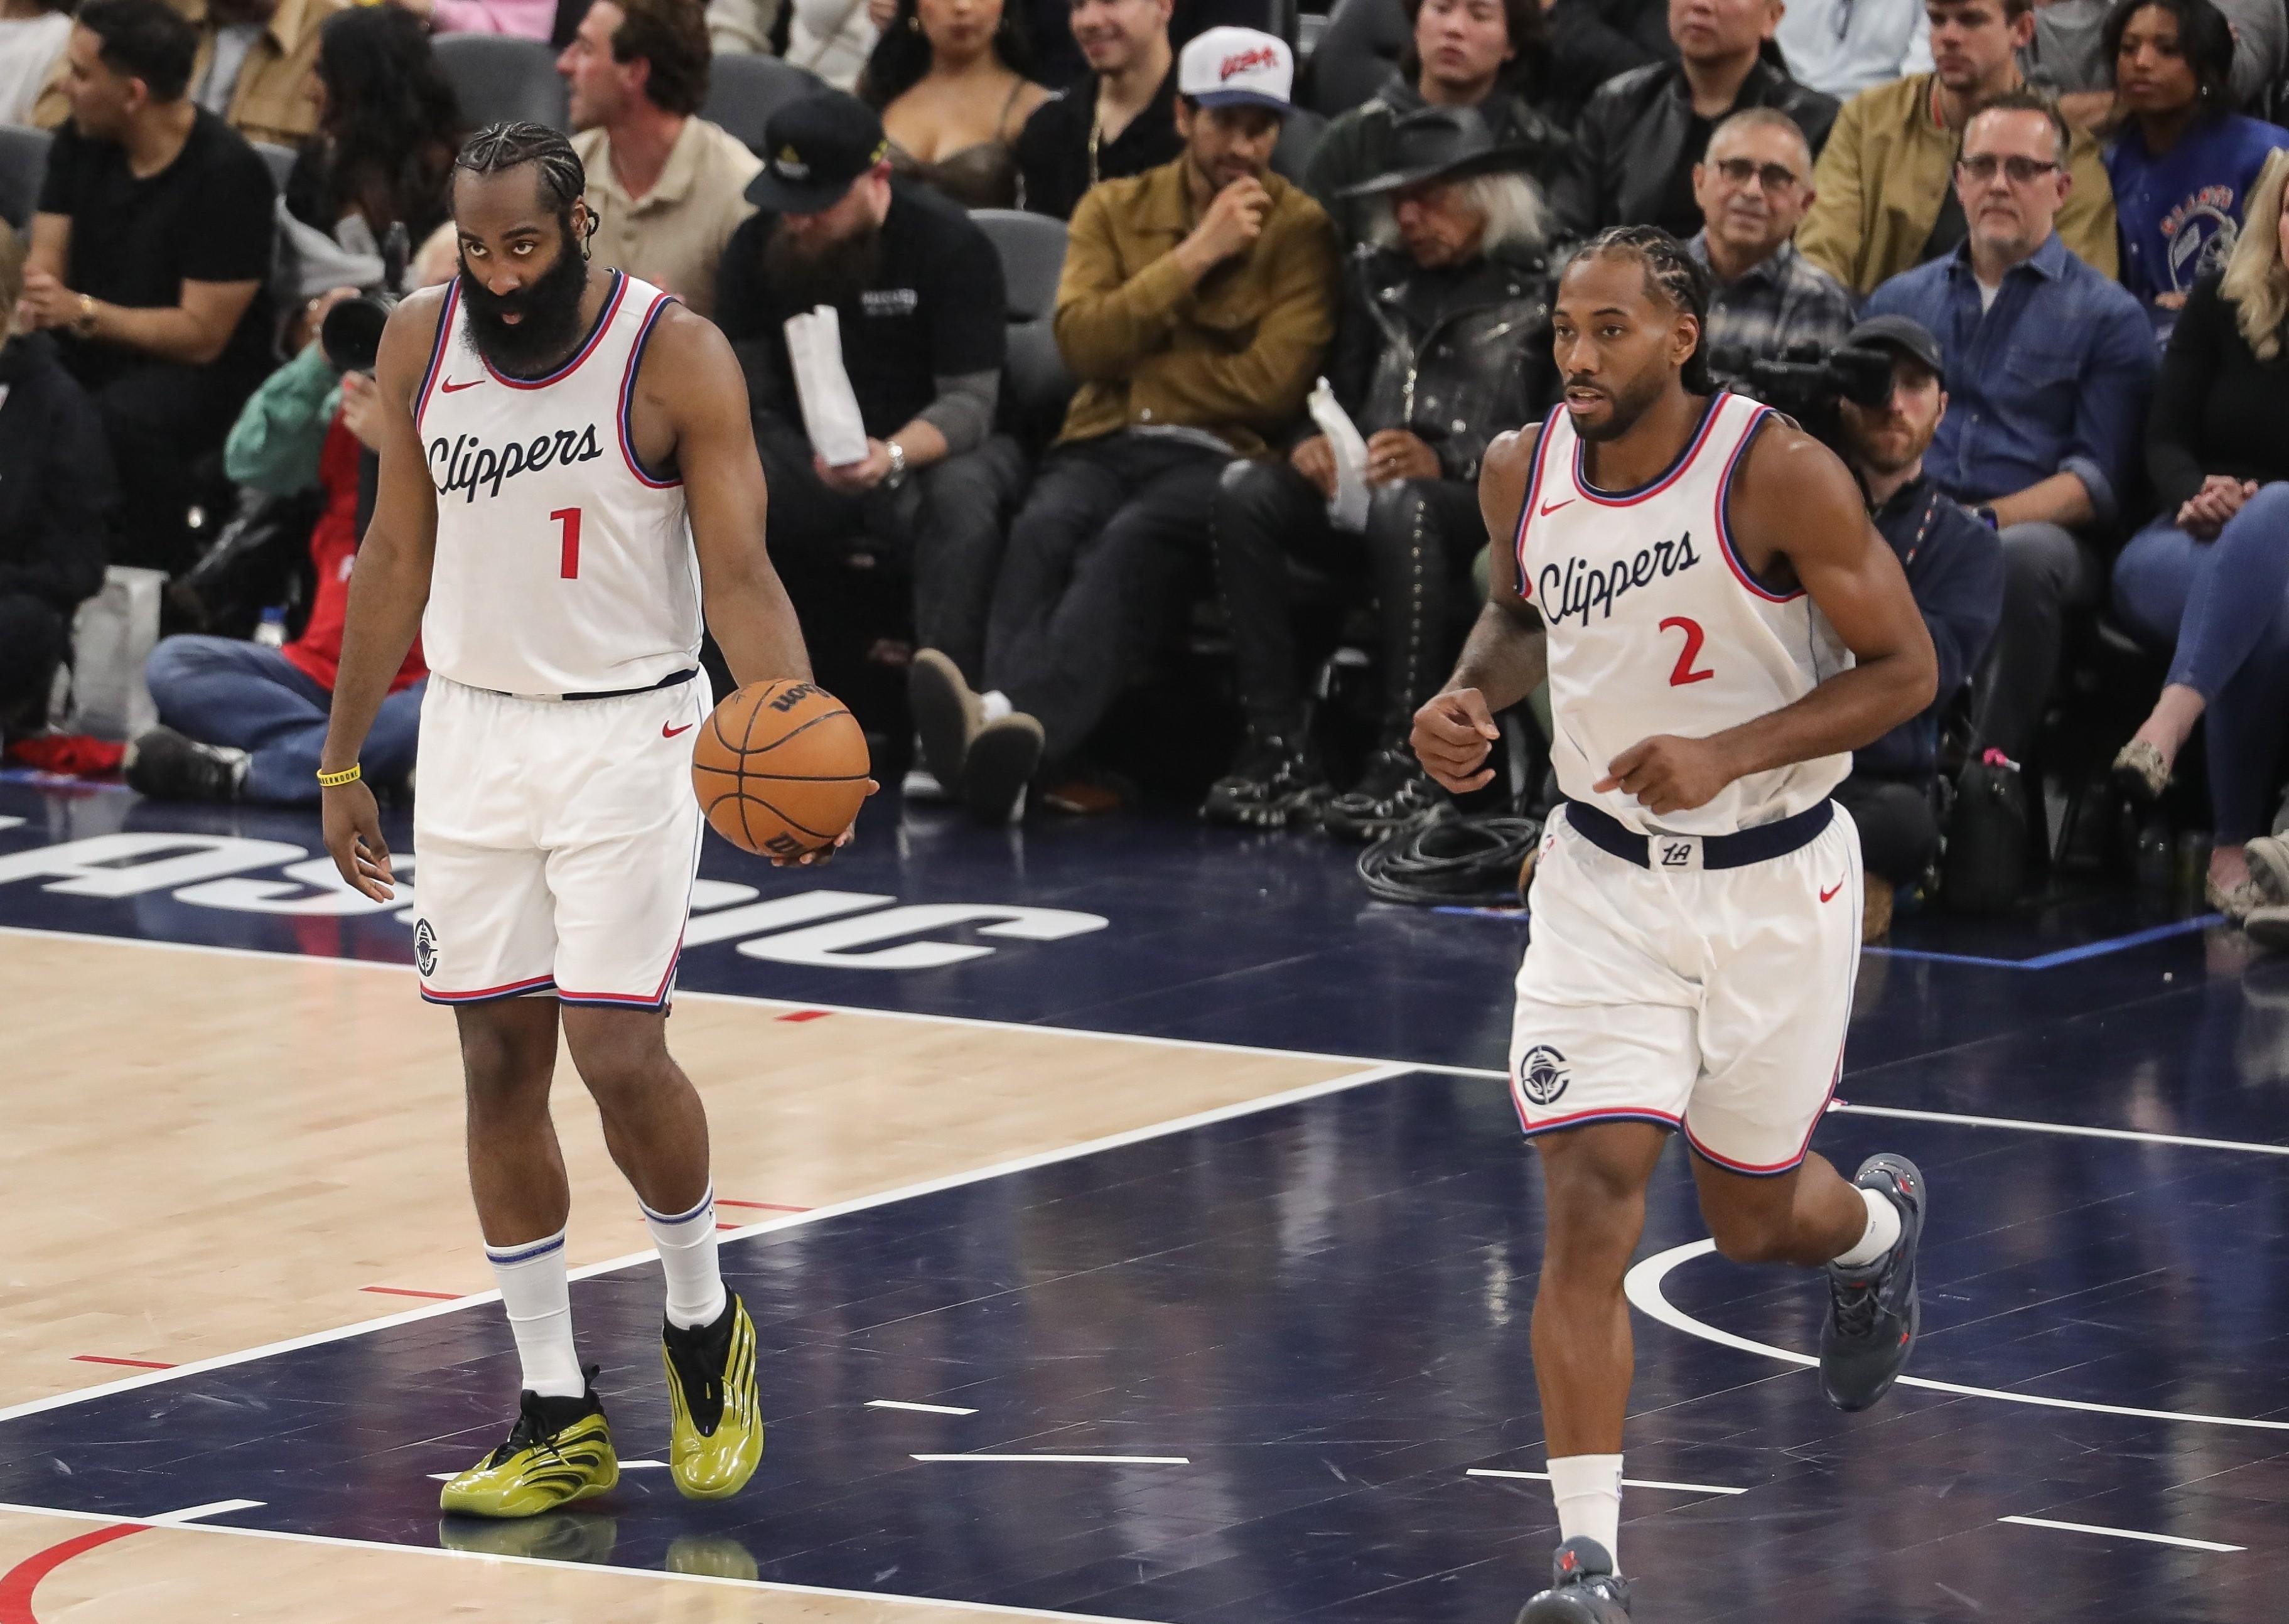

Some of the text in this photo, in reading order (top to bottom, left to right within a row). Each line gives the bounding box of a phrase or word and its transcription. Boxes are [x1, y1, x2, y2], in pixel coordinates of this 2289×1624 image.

[429, 423, 604, 503] Clippers
[550, 508, 581, 579] 1
[1539, 530, 1701, 626] Clippers
[1659, 616, 1715, 687] 2
[1661, 842, 1691, 866] LA
